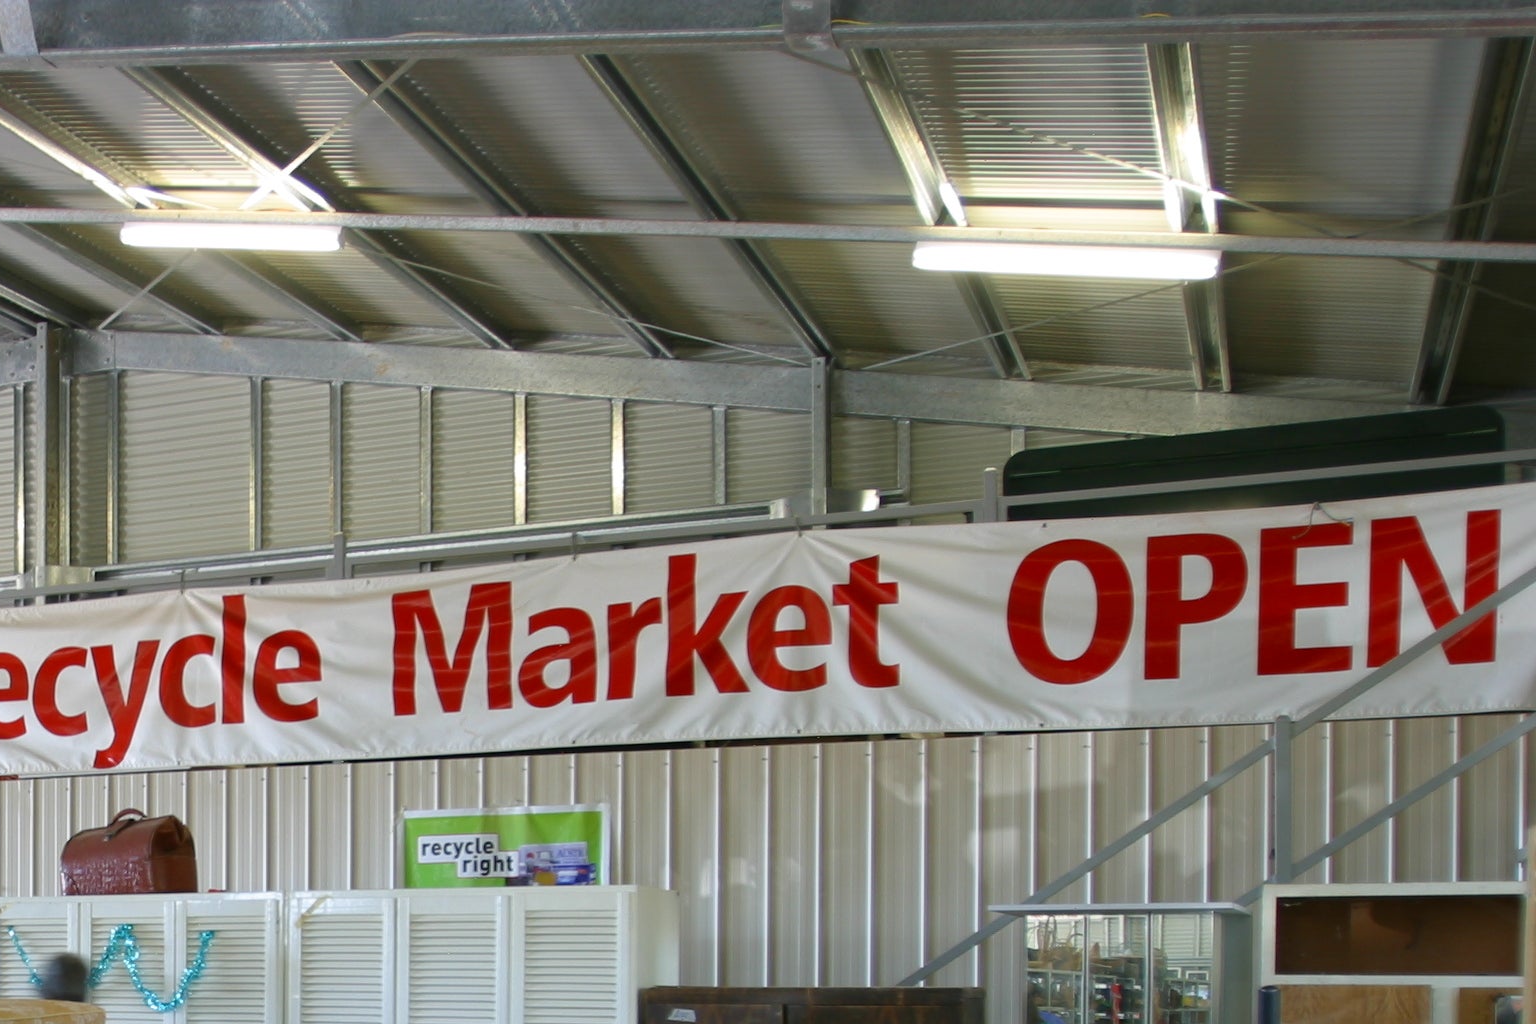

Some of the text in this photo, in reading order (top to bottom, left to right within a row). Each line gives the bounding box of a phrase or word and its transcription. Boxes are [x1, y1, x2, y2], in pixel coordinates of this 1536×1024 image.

[392, 555, 899, 716] Market
[1007, 509, 1501, 685] OPEN
[421, 838, 494, 858] recycle
[462, 855, 514, 876] right
